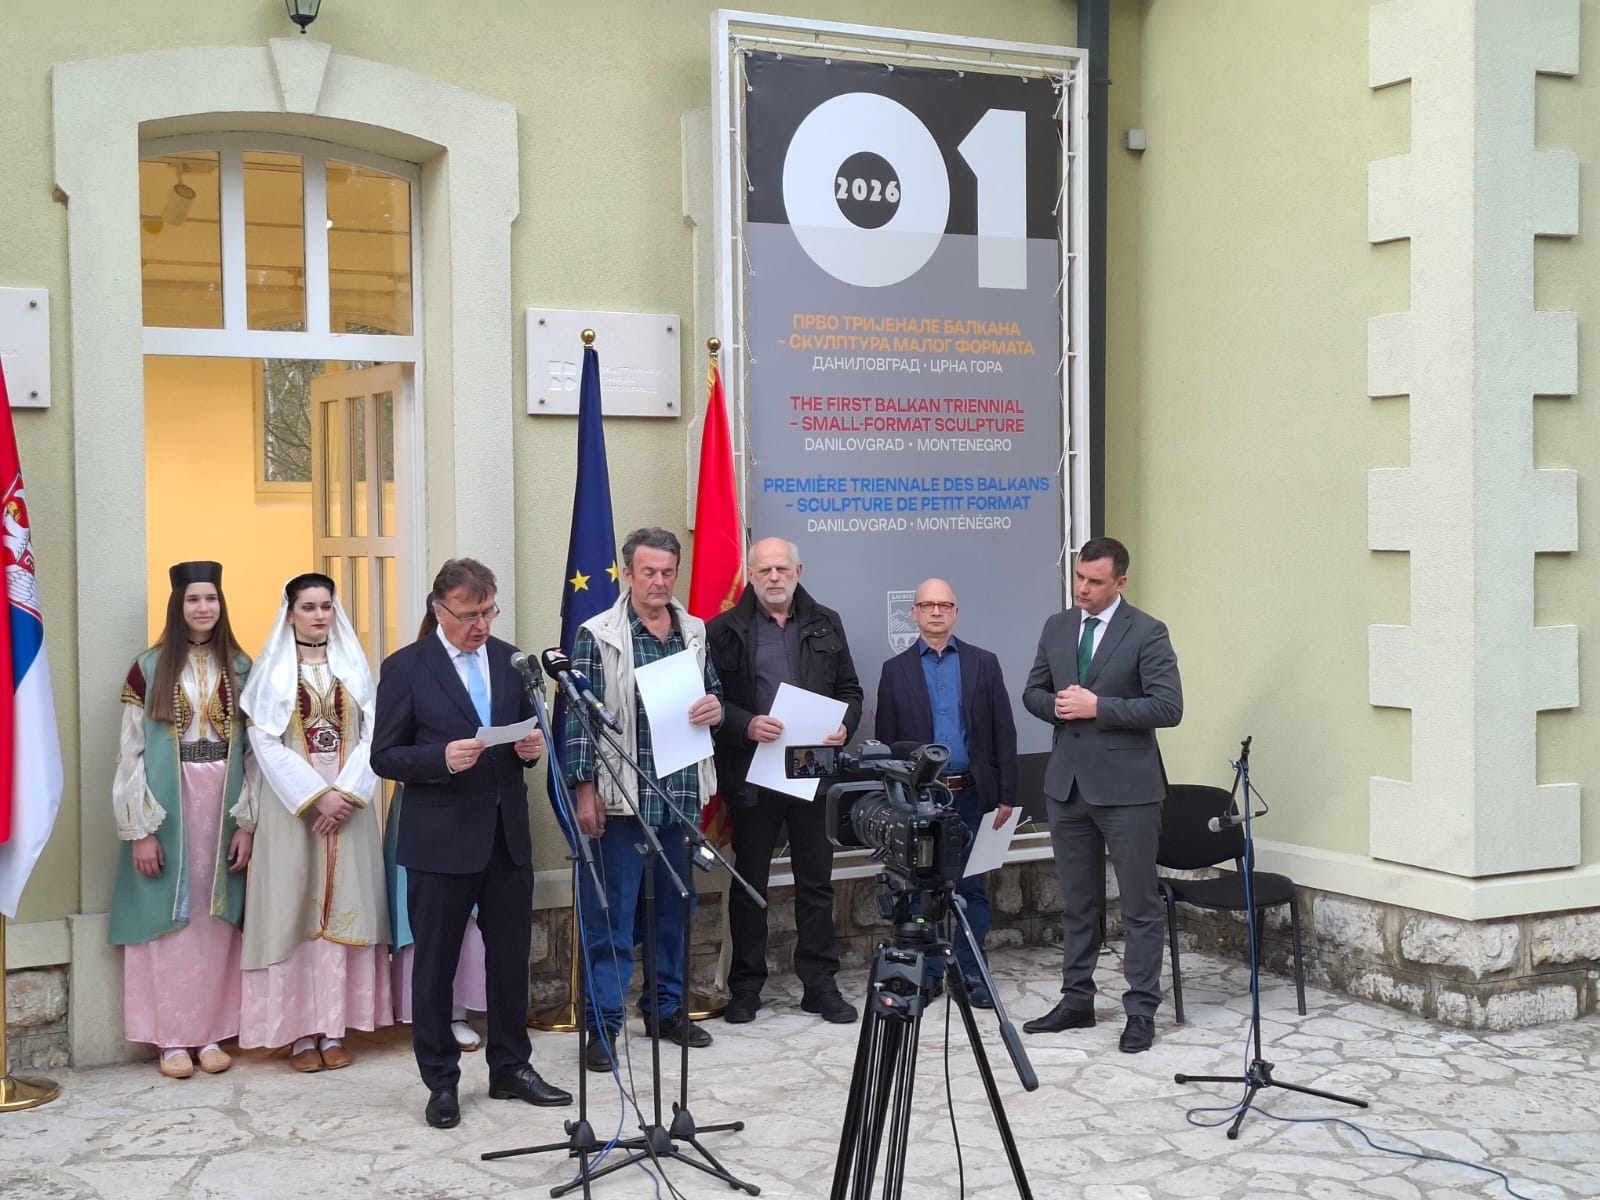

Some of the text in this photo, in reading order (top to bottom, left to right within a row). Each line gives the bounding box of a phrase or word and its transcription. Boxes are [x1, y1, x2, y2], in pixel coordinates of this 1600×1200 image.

[783, 92, 1028, 290] 01
[835, 176, 901, 204] 2026
[792, 313, 1021, 337] ПРВО ТРИЈЕНАЛЕ БАЛКАНА
[789, 334, 890, 353] СКУЛПТУРА
[893, 338, 951, 354] МАЛОГ
[954, 340, 1035, 356] ФОРМАТА
[812, 356, 1003, 375] ДАНИЛОВГРАД ЦРНА ГОРА
[790, 395, 1025, 415] THE FIRST BALKAN TRIENNIAL
[801, 416, 932, 433] SMALL-FORMAT
[935, 417, 1025, 434] SCULPTURE
[804, 437, 1012, 452] DANILOVGRAD MONTENEGRO
[763, 473, 1050, 494] PREMIÈRE TRIENNALE DES BALKANS
[797, 497, 894, 513] SCULPTURE
[896, 496, 918, 512] DE
[921, 496, 963, 512] PETIT
[966, 495, 1032, 511] FORMAT
[807, 513, 1012, 533] DANILOVGRAD MONTÉNÉGRO
